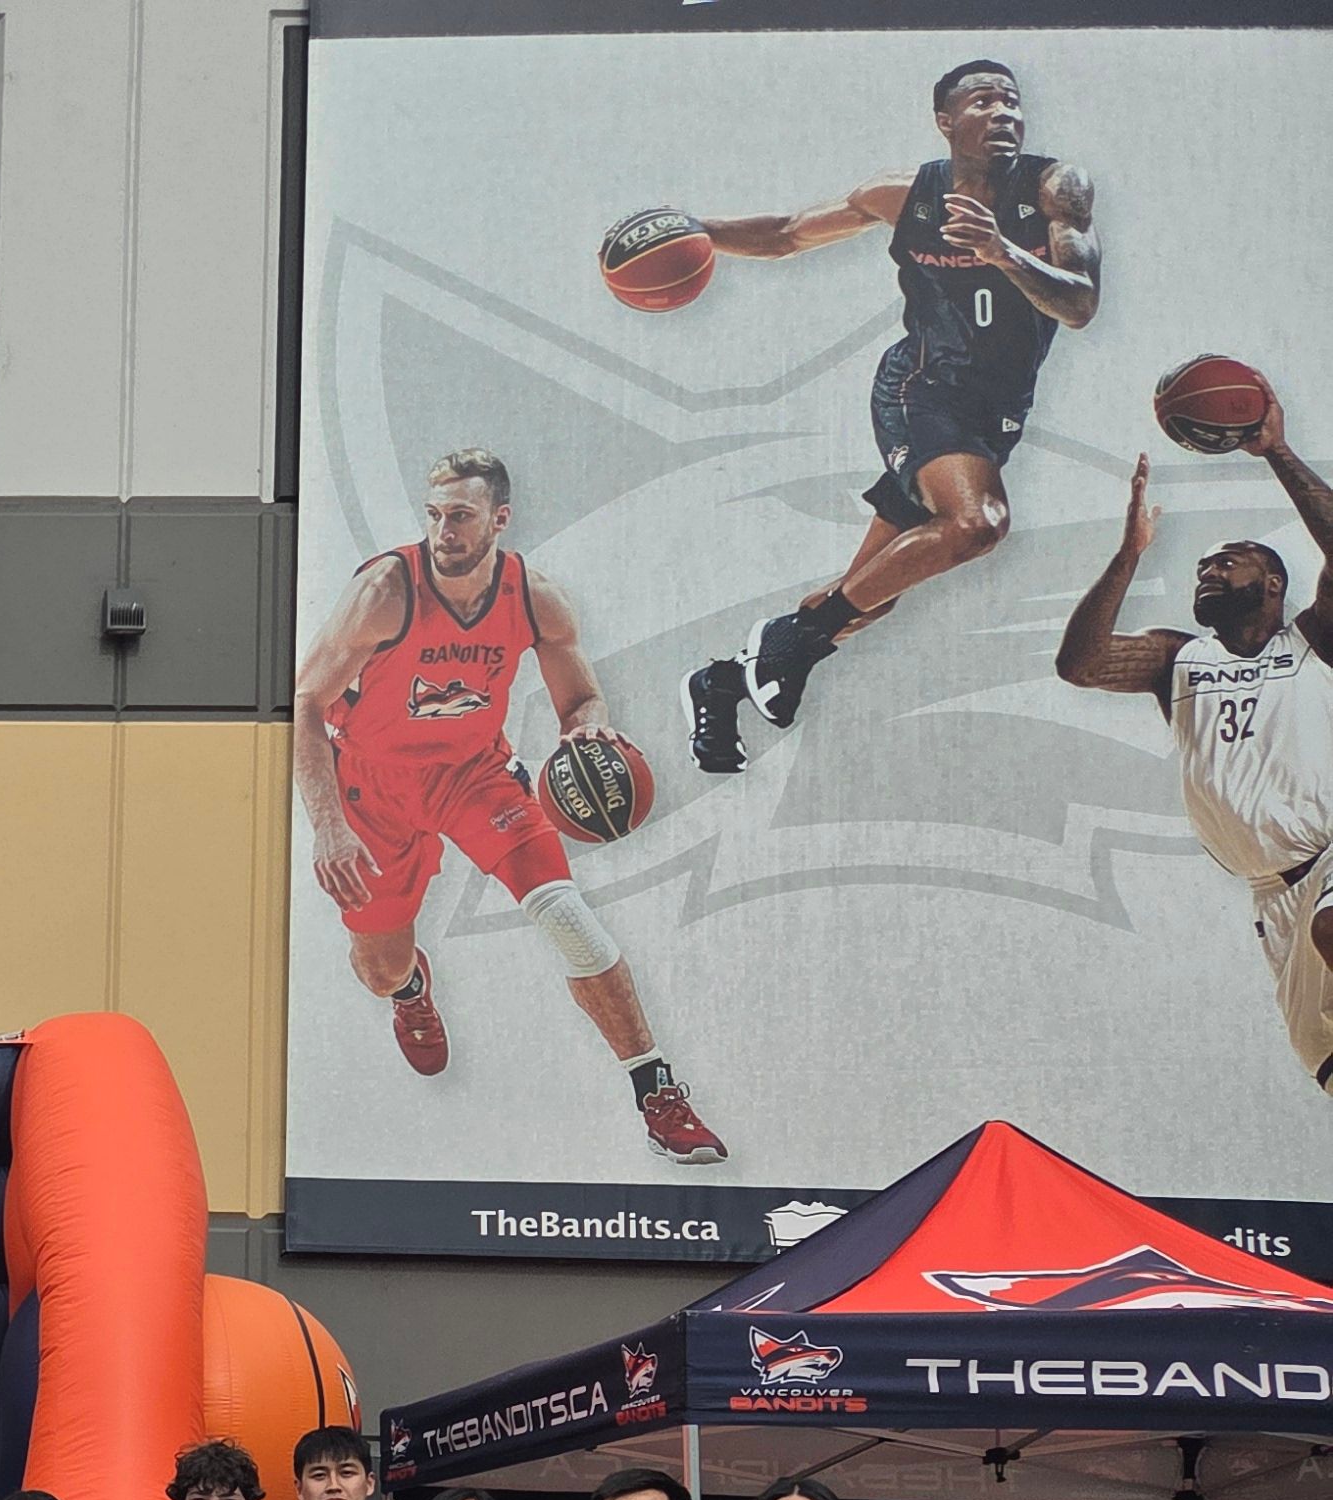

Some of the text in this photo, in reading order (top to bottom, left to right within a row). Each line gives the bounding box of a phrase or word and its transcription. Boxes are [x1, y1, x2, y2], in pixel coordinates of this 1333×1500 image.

[974, 289, 992, 327] 0
[419, 642, 505, 665] BANDITS
[1220, 698, 1258, 742] 32
[579, 741, 626, 813] SPALDING
[471, 1210, 720, 1241] TheBandits.ca
[1223, 1228, 1291, 1257] dits
[741, 1388, 853, 1397] VANCOUVER
[906, 1358, 1333, 1401] THEBAND
[729, 1397, 868, 1412] BANDITS
